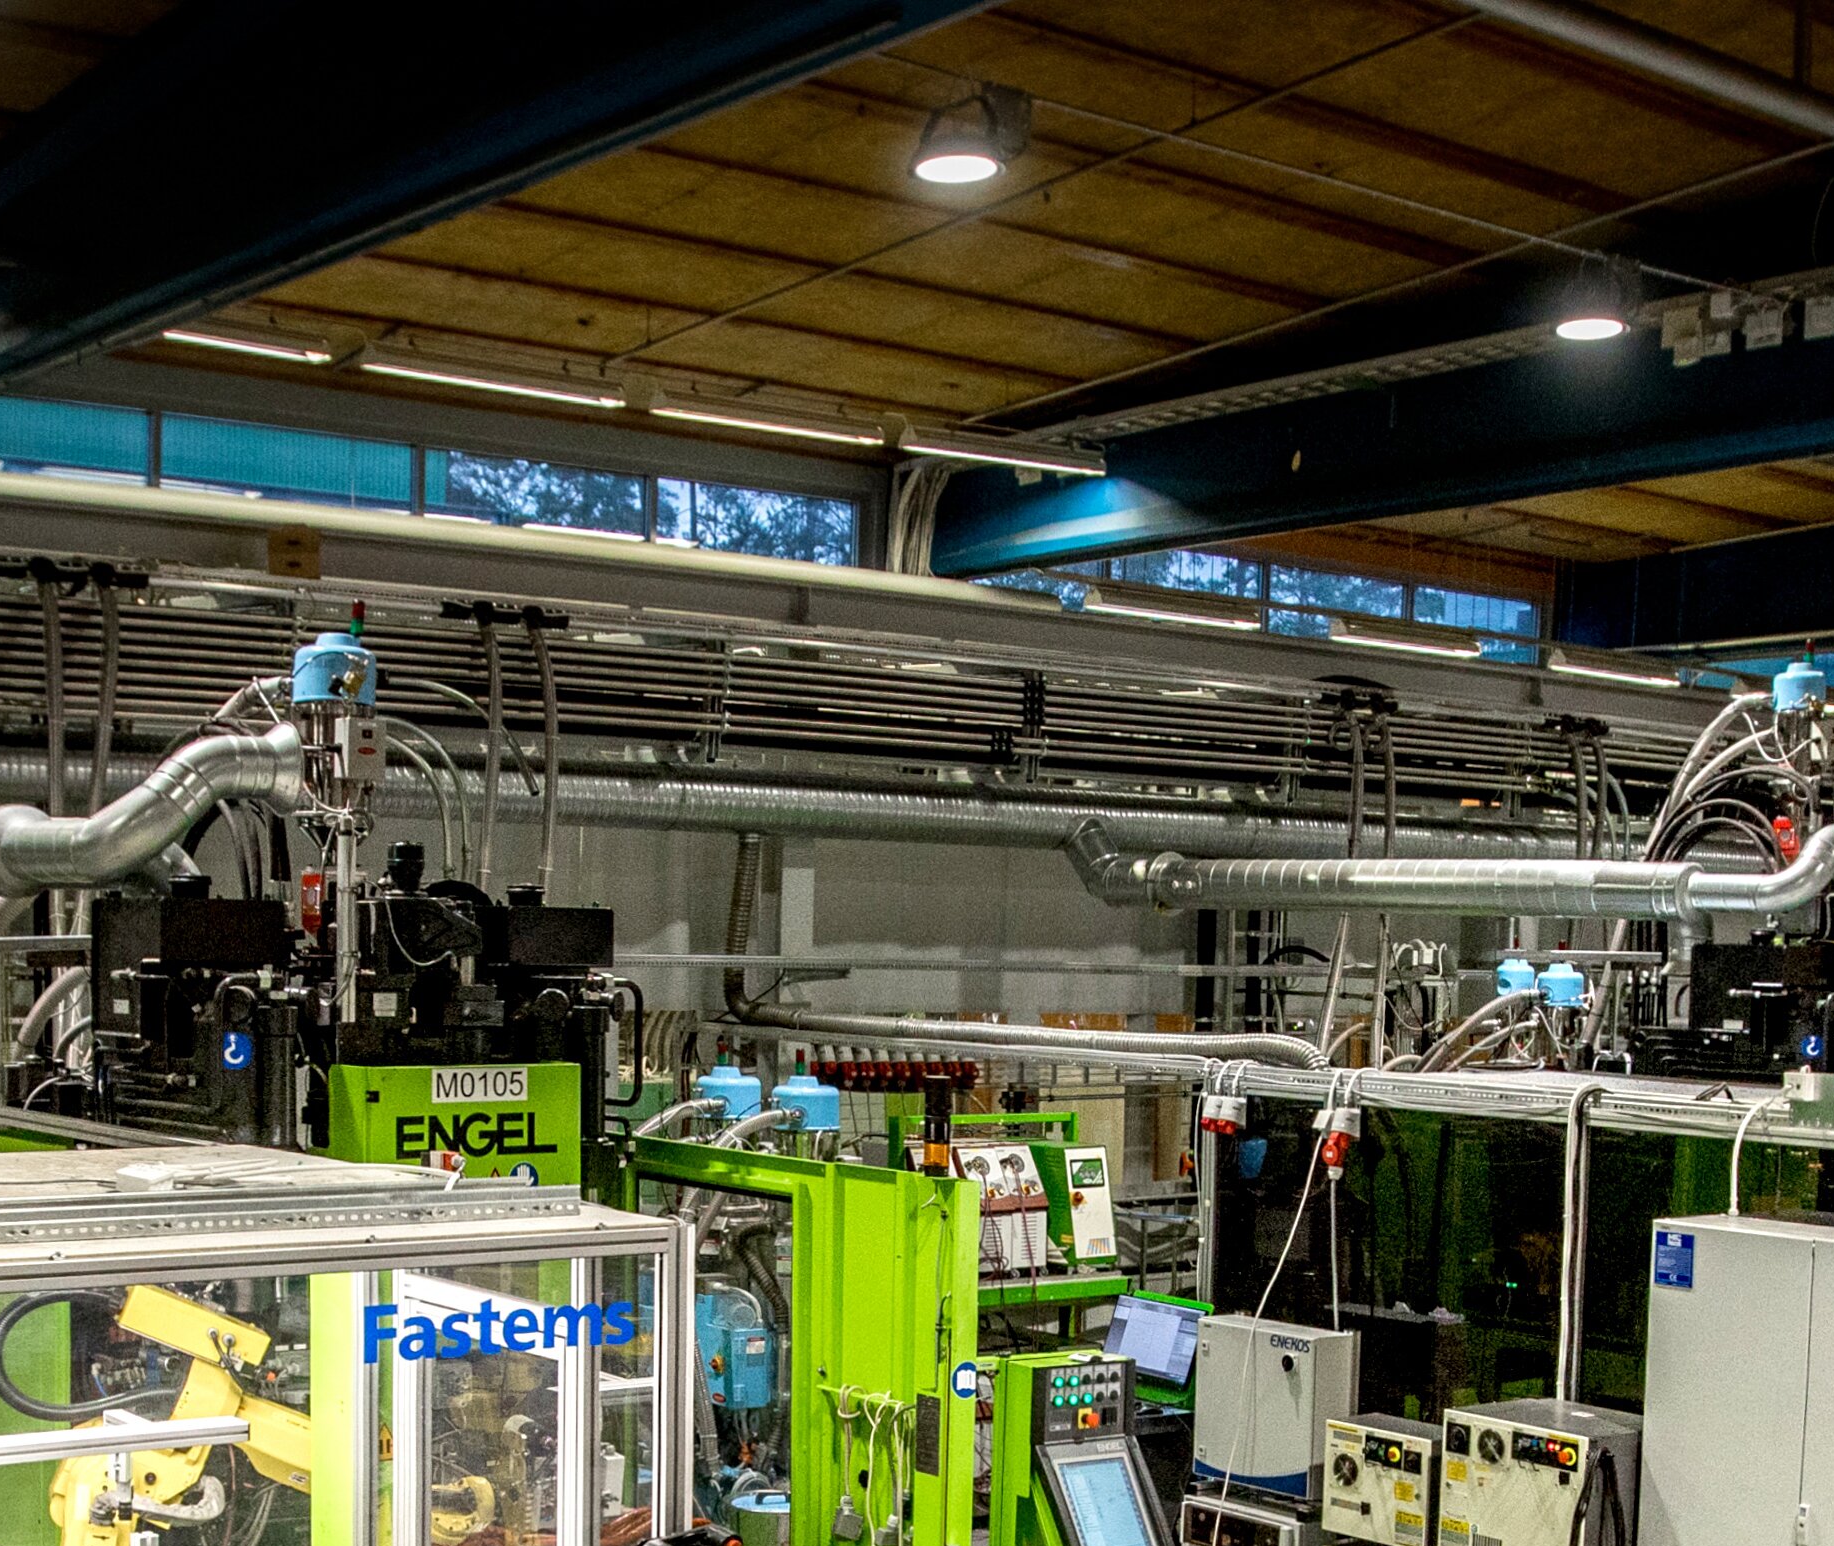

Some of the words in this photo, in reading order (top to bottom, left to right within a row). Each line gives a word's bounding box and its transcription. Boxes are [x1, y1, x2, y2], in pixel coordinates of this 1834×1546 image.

[436, 1071, 524, 1098] M0105
[396, 1111, 558, 1160] ENGEL
[363, 1299, 636, 1364] Fastems
[1270, 1334, 1311, 1353] ENEKOS
